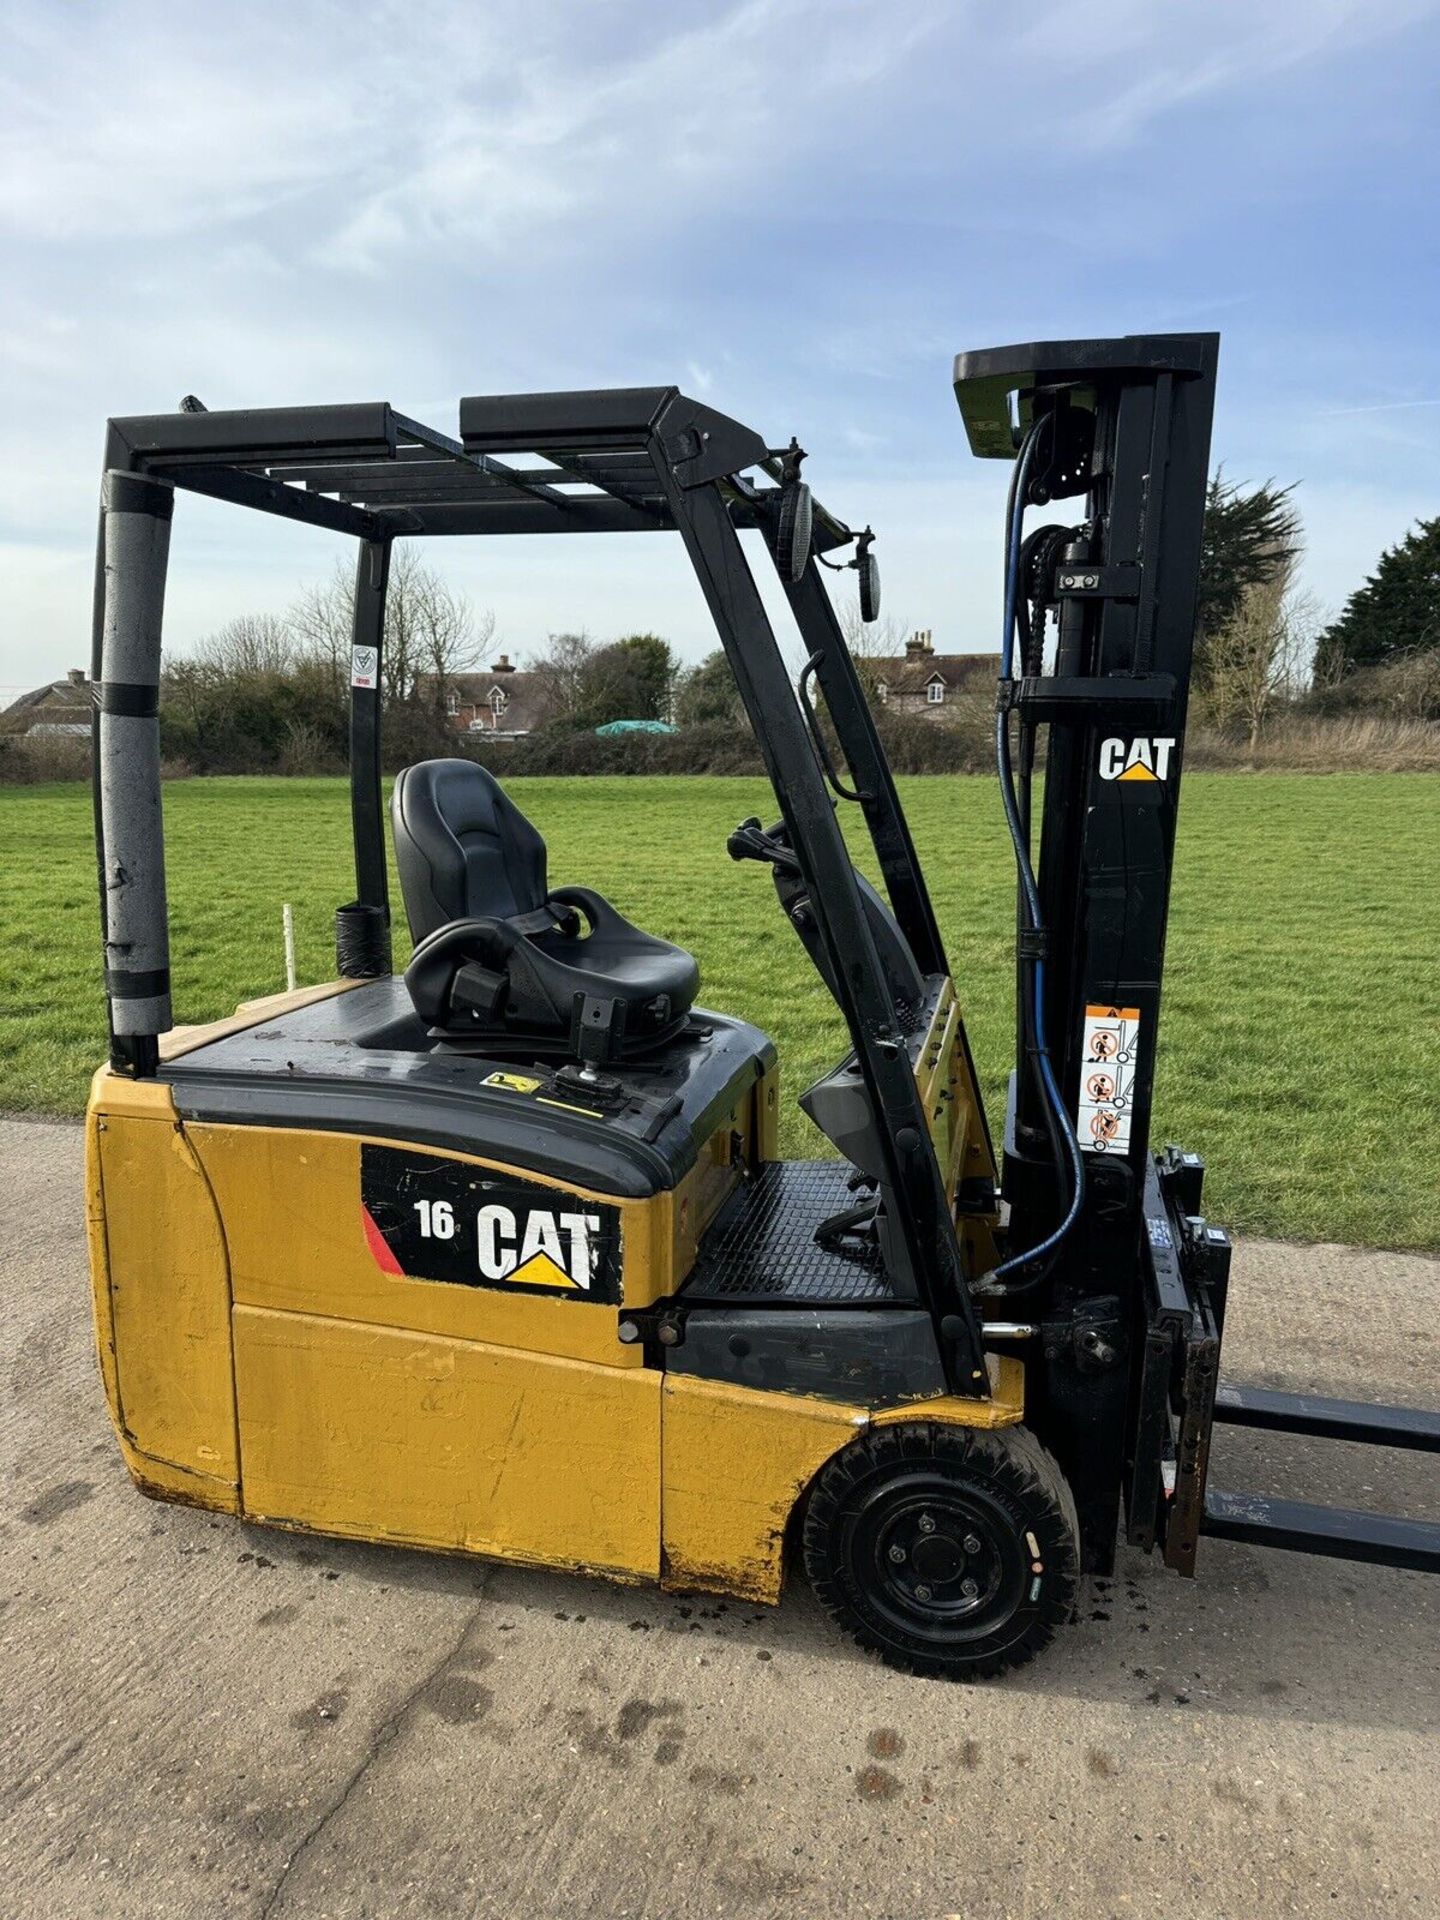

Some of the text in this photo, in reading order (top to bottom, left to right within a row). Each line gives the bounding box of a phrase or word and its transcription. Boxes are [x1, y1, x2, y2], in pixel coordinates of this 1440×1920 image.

[1099, 738, 1176, 781] CAT
[414, 1199, 600, 1290] 16 CAT
